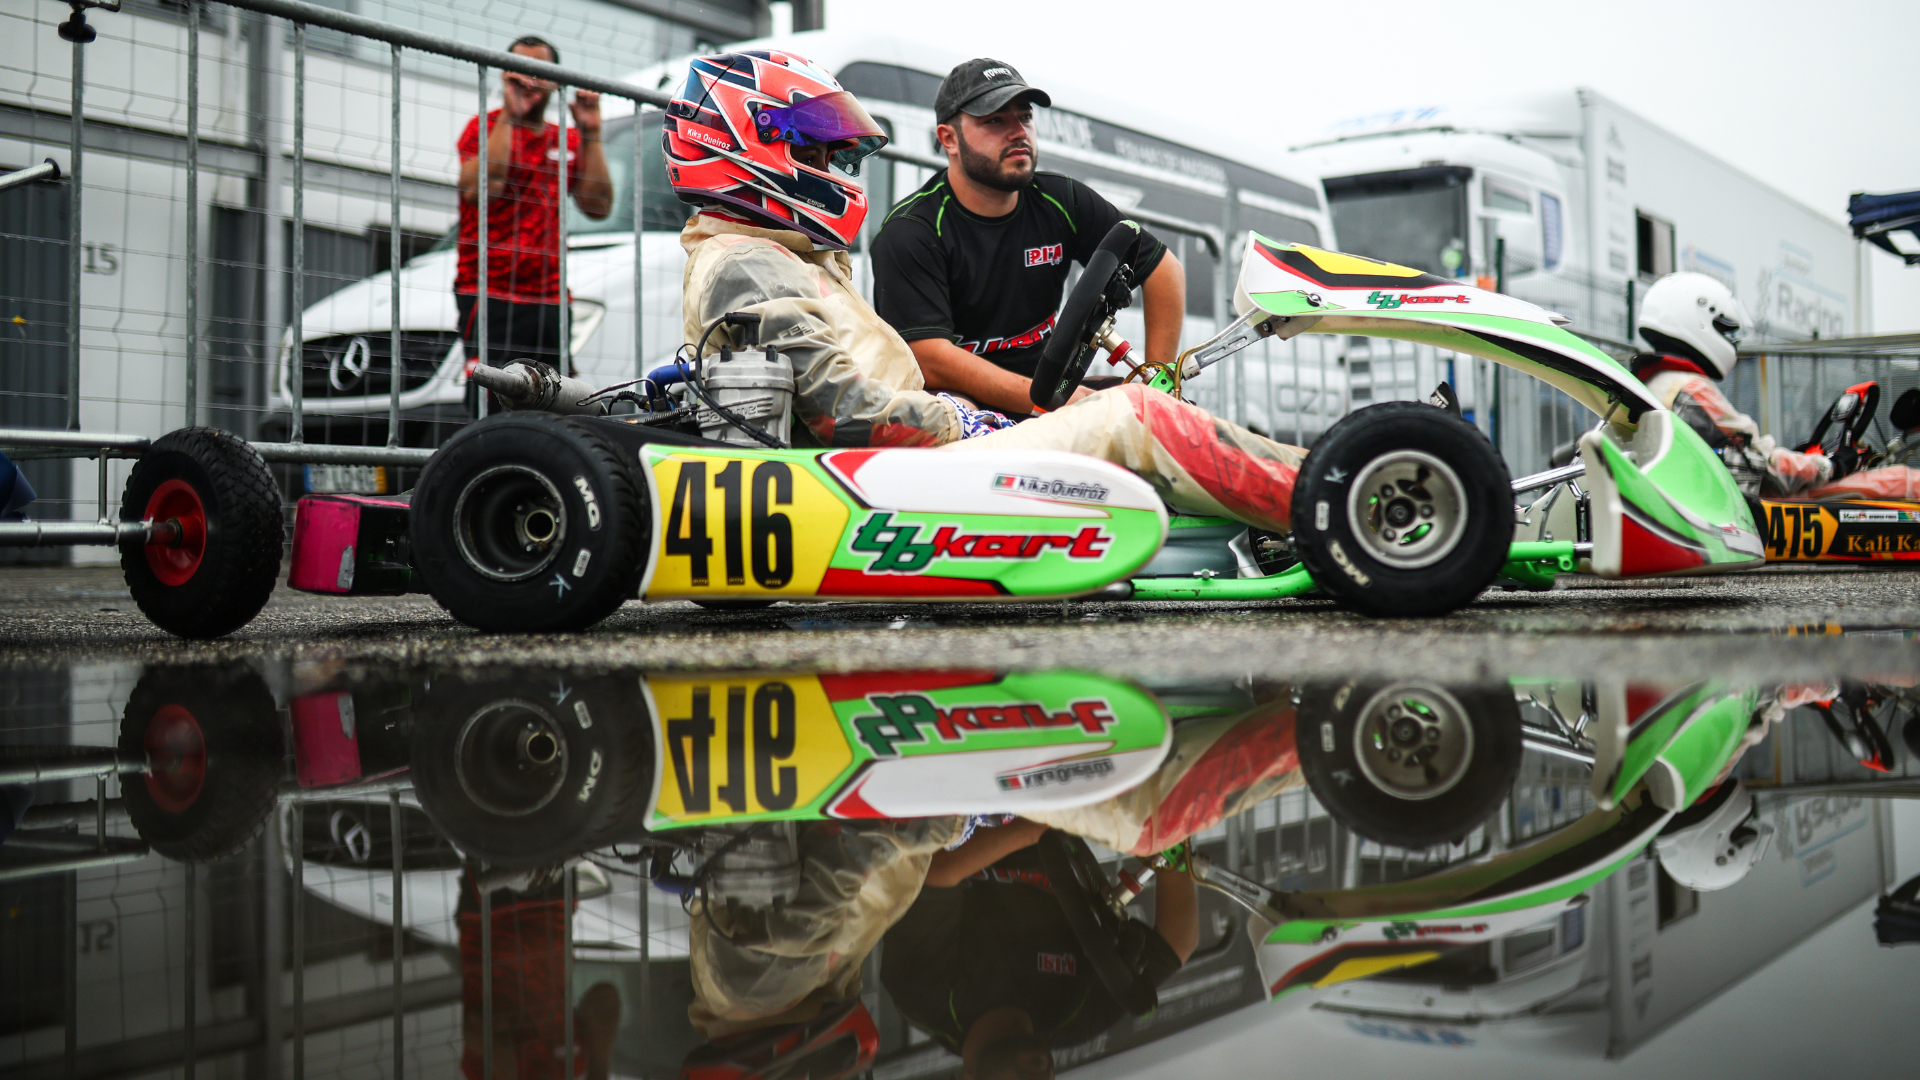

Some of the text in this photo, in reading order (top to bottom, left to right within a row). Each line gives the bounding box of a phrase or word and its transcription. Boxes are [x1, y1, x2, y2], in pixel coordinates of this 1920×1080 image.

[686, 127, 731, 150] Kika Queiroz
[83, 242, 118, 275] 15
[1017, 477, 1049, 494] Kika
[666, 460, 793, 590] 416
[1768, 506, 1823, 558] 475
[1847, 534, 1890, 553] Kali
